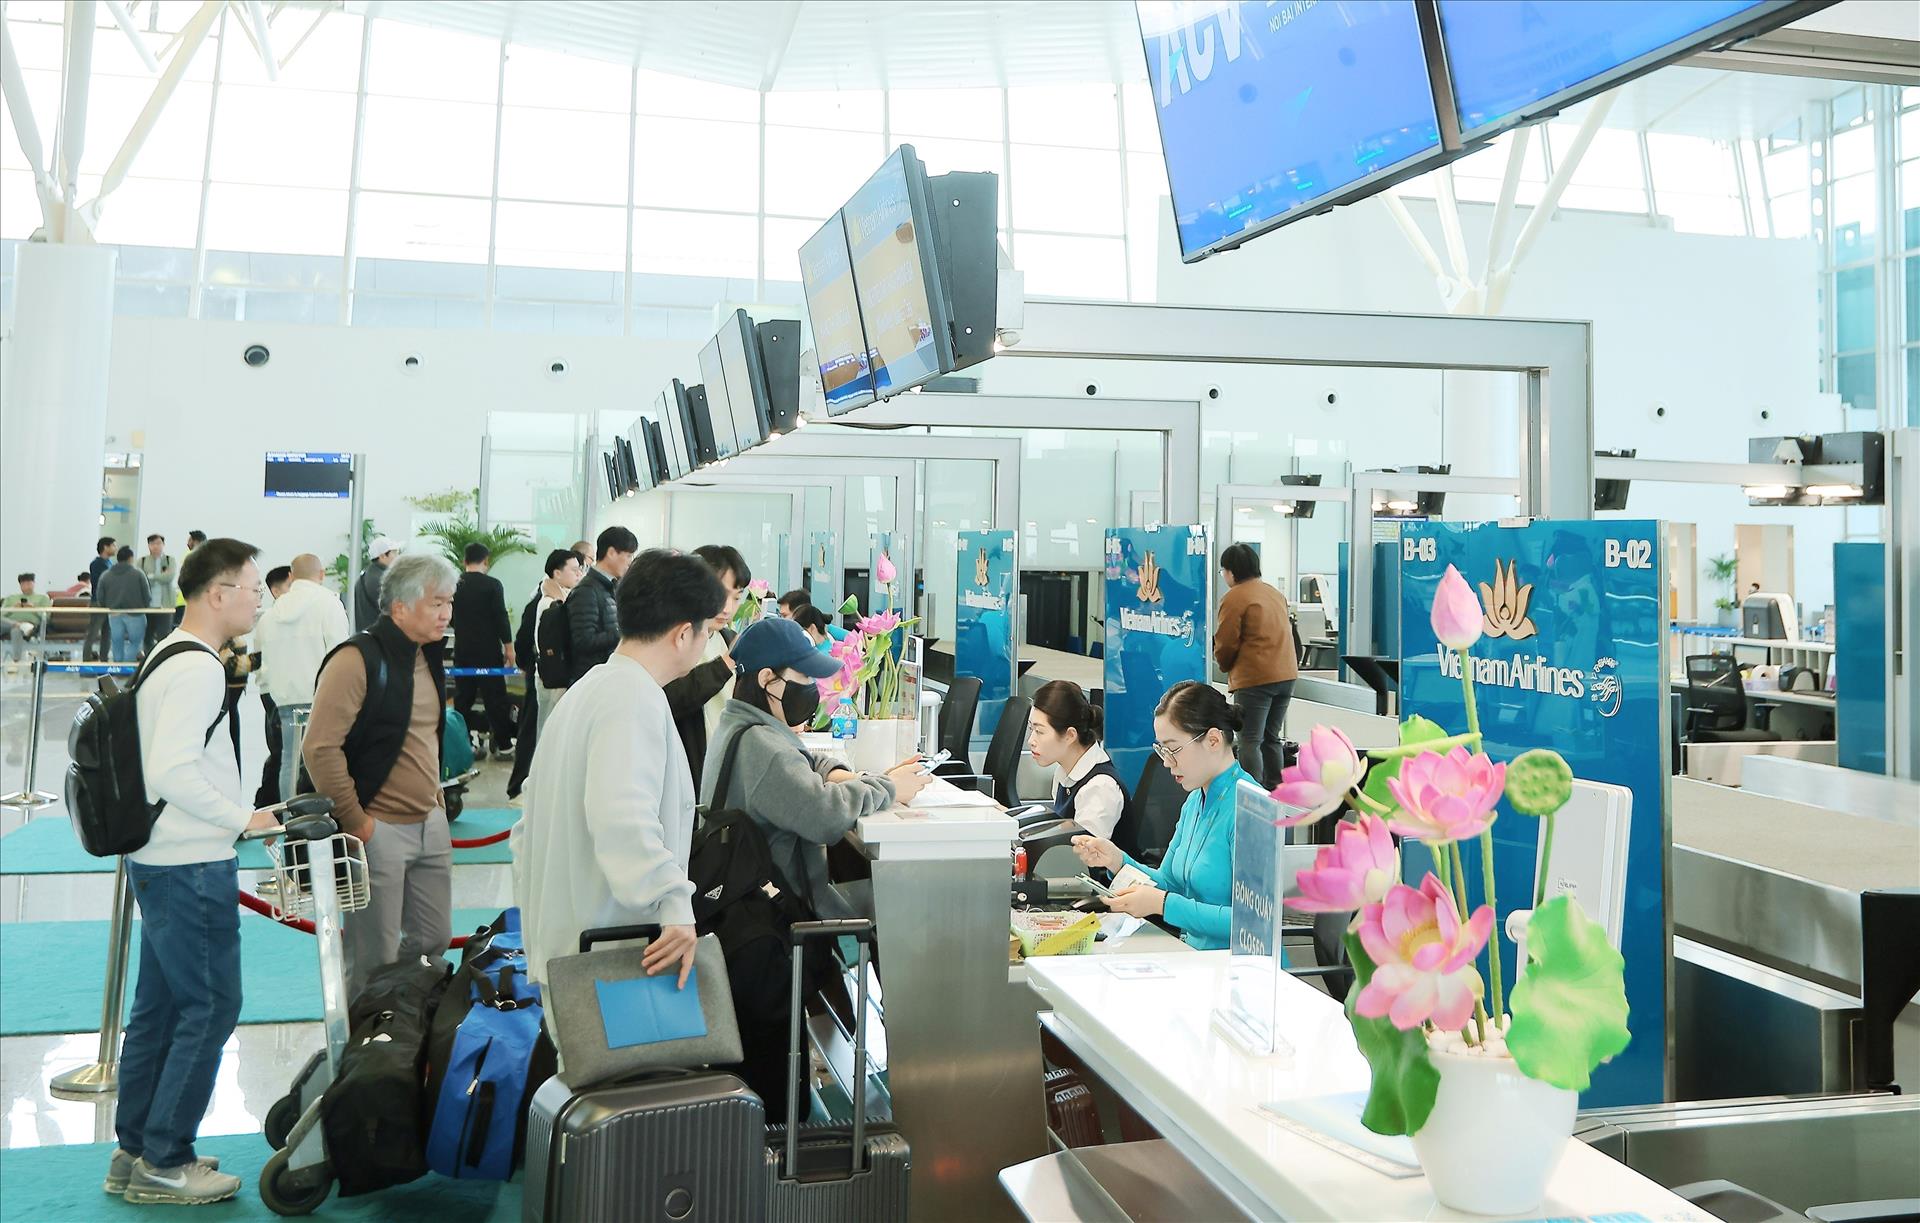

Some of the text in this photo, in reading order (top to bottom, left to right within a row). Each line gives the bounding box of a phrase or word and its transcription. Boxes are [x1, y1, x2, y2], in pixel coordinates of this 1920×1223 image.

[1403, 537, 1436, 562] B-03
[1605, 539, 1652, 569] B-02
[1436, 643, 1509, 687] Vienam
[1235, 880, 1254, 911] ĐÓNG
